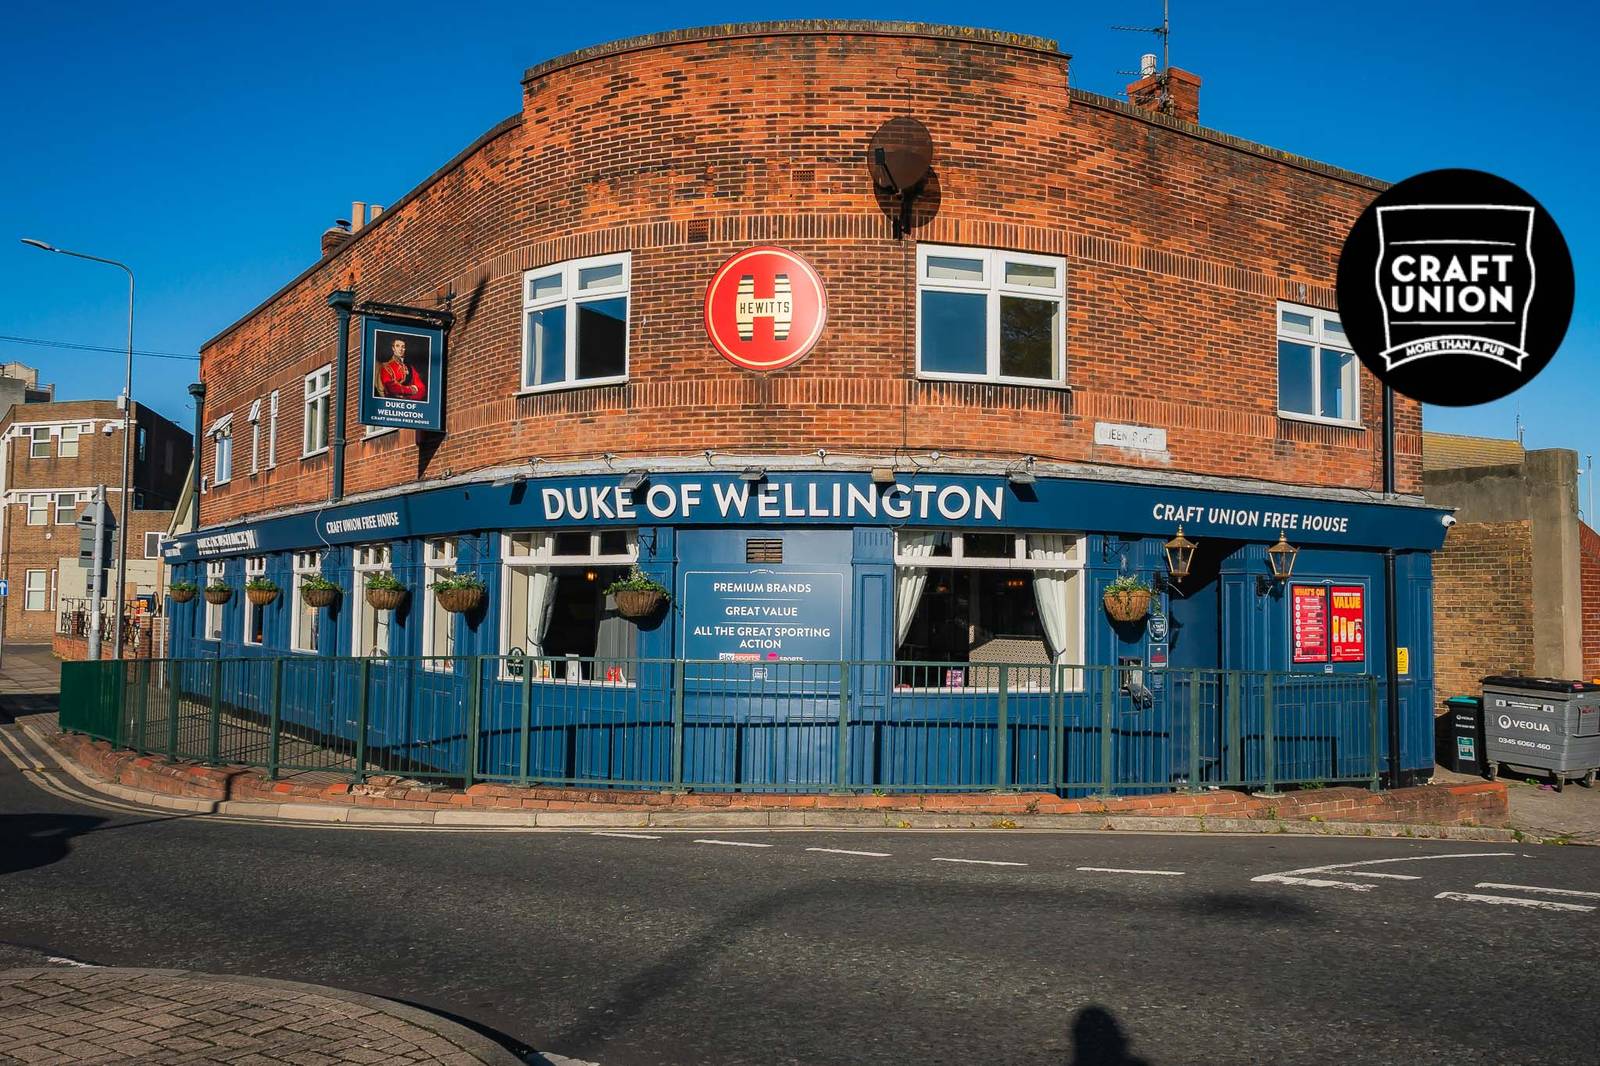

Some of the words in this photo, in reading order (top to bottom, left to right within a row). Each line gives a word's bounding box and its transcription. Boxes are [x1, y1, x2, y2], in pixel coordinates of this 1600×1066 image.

[740, 302, 790, 314] HEWITTS
[378, 409, 424, 418] WELLINGTON
[542, 486, 636, 520] DUKE
[646, 484, 701, 518] OF
[712, 483, 1003, 520] WELLINGTON
[326, 521, 342, 534] CRAFT
[343, 517, 362, 532] UNION
[362, 515, 377, 529] FREE
[377, 512, 400, 528] HOUSE
[1153, 503, 1204, 523] CRAFT
[1208, 508, 1259, 527] UNION
[1263, 512, 1298, 529] FREE
[1302, 515, 1348, 532] HOUSE
[714, 583, 764, 592] PREMIUM
[767, 583, 812, 593] BRANDS
[1333, 596, 1361, 608] VALUE
[725, 607, 760, 616] GREAT
[762, 607, 798, 616] VALUE
[694, 627, 712, 636] ALL
[714, 627, 735, 636] THE
[737, 627, 772, 637] GREAT
[774, 627, 830, 637] SPORTING
[740, 639, 782, 649] ACTION
[1512, 720, 1550, 732] VEOLIA
[1498, 737, 1516, 745] 0345
[1517, 739, 1536, 748] 6060
[1537, 742, 1551, 751] 460
